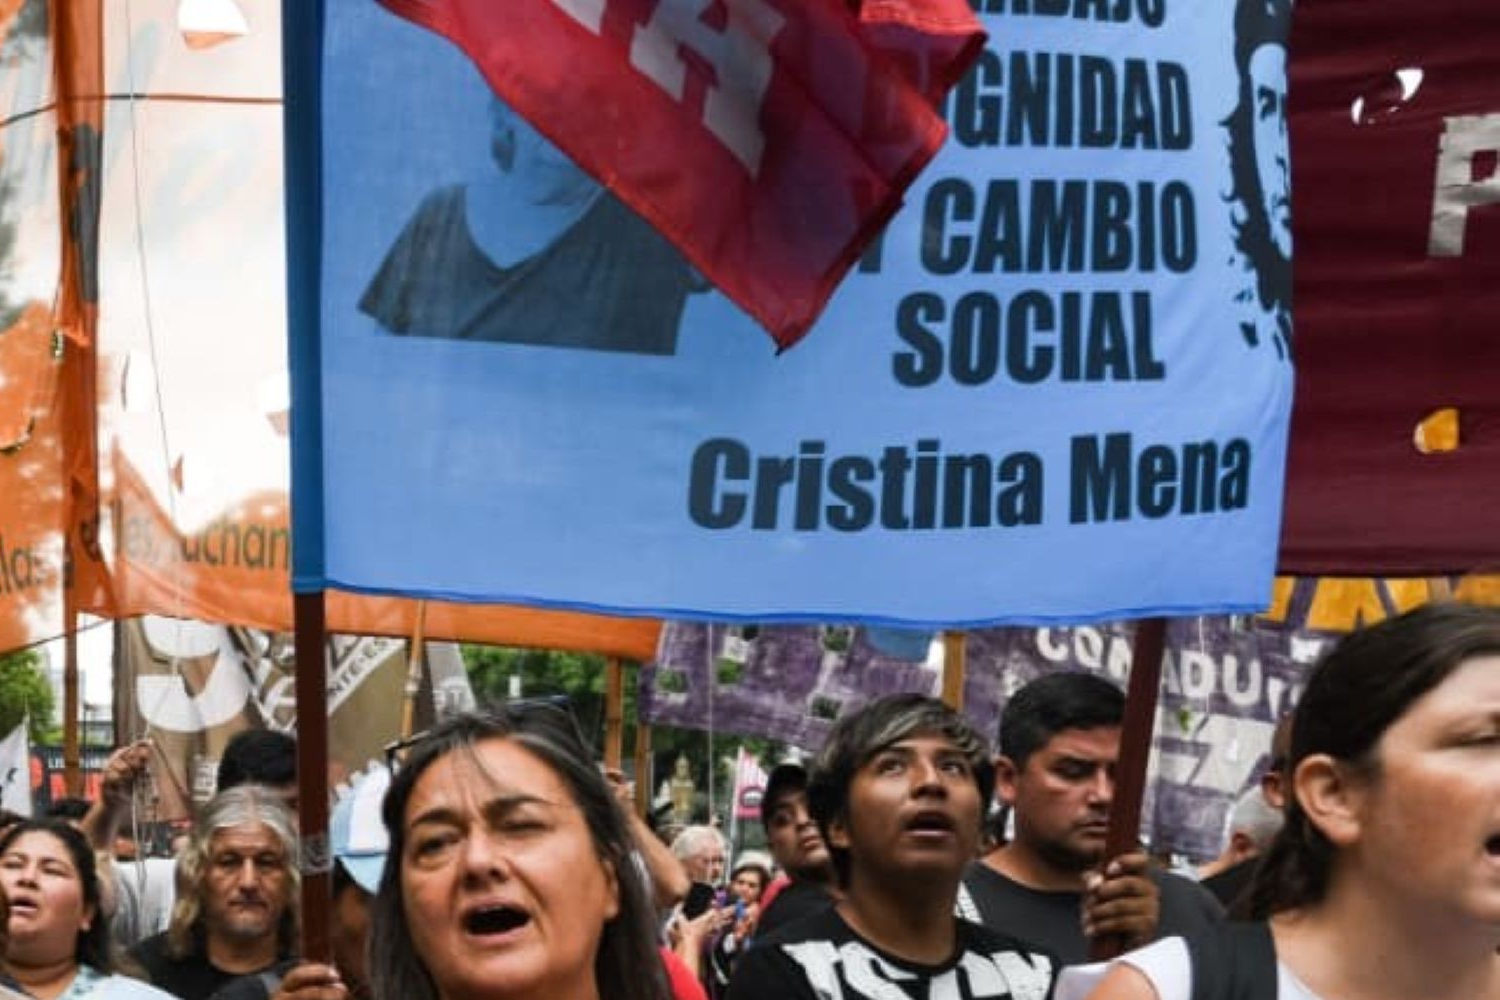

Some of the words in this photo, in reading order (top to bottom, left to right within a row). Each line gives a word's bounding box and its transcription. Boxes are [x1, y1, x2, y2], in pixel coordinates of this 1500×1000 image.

[937, 49, 1193, 151] GNIDAD
[919, 177, 1198, 276] CAMBIO
[891, 289, 1166, 388] SOCIAL
[687, 437, 1044, 533] Cristina
[1068, 432, 1252, 526] Mena
[174, 513, 290, 570] uchan
